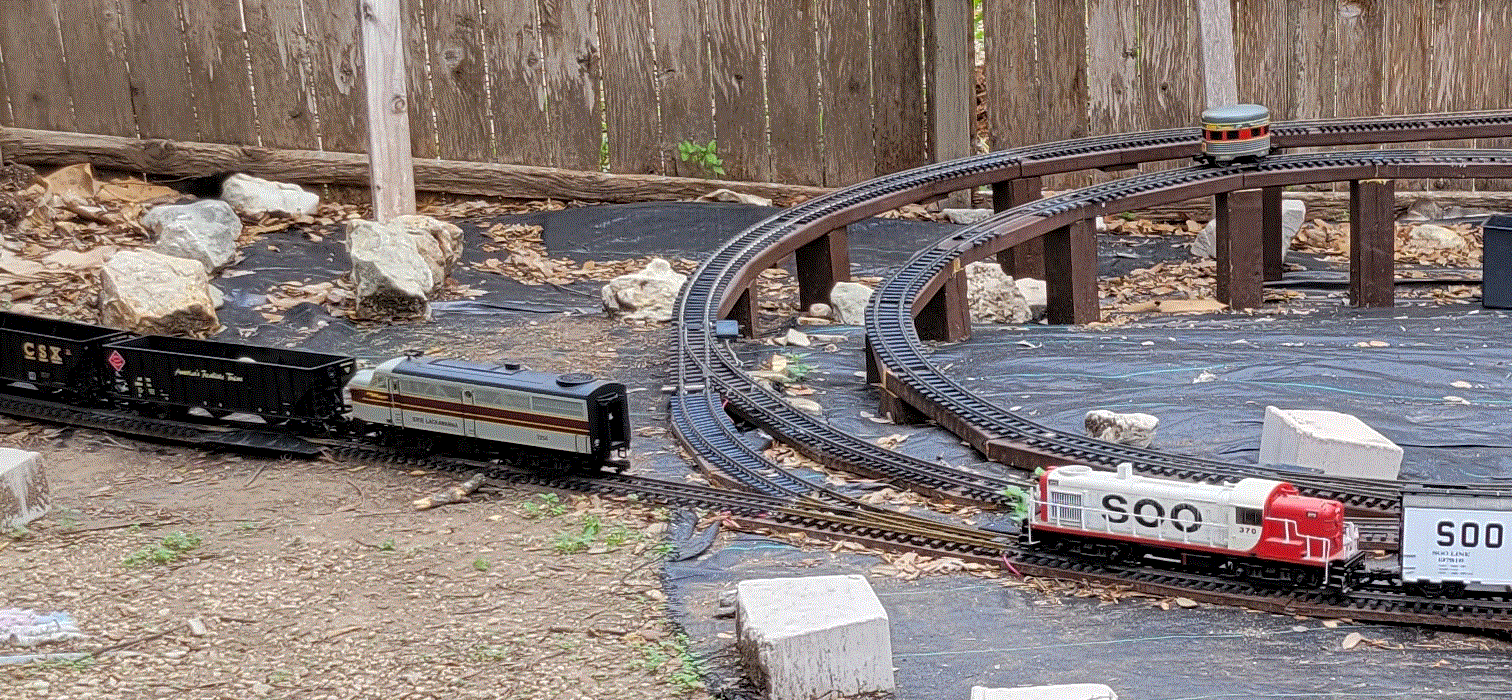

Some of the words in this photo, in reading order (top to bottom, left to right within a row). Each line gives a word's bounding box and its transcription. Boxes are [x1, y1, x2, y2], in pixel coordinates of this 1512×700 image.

[23, 341, 63, 364] CSX
[1101, 493, 1203, 534] SOO
[1239, 526, 1257, 535] 370
[1437, 521, 1504, 548] SOO
